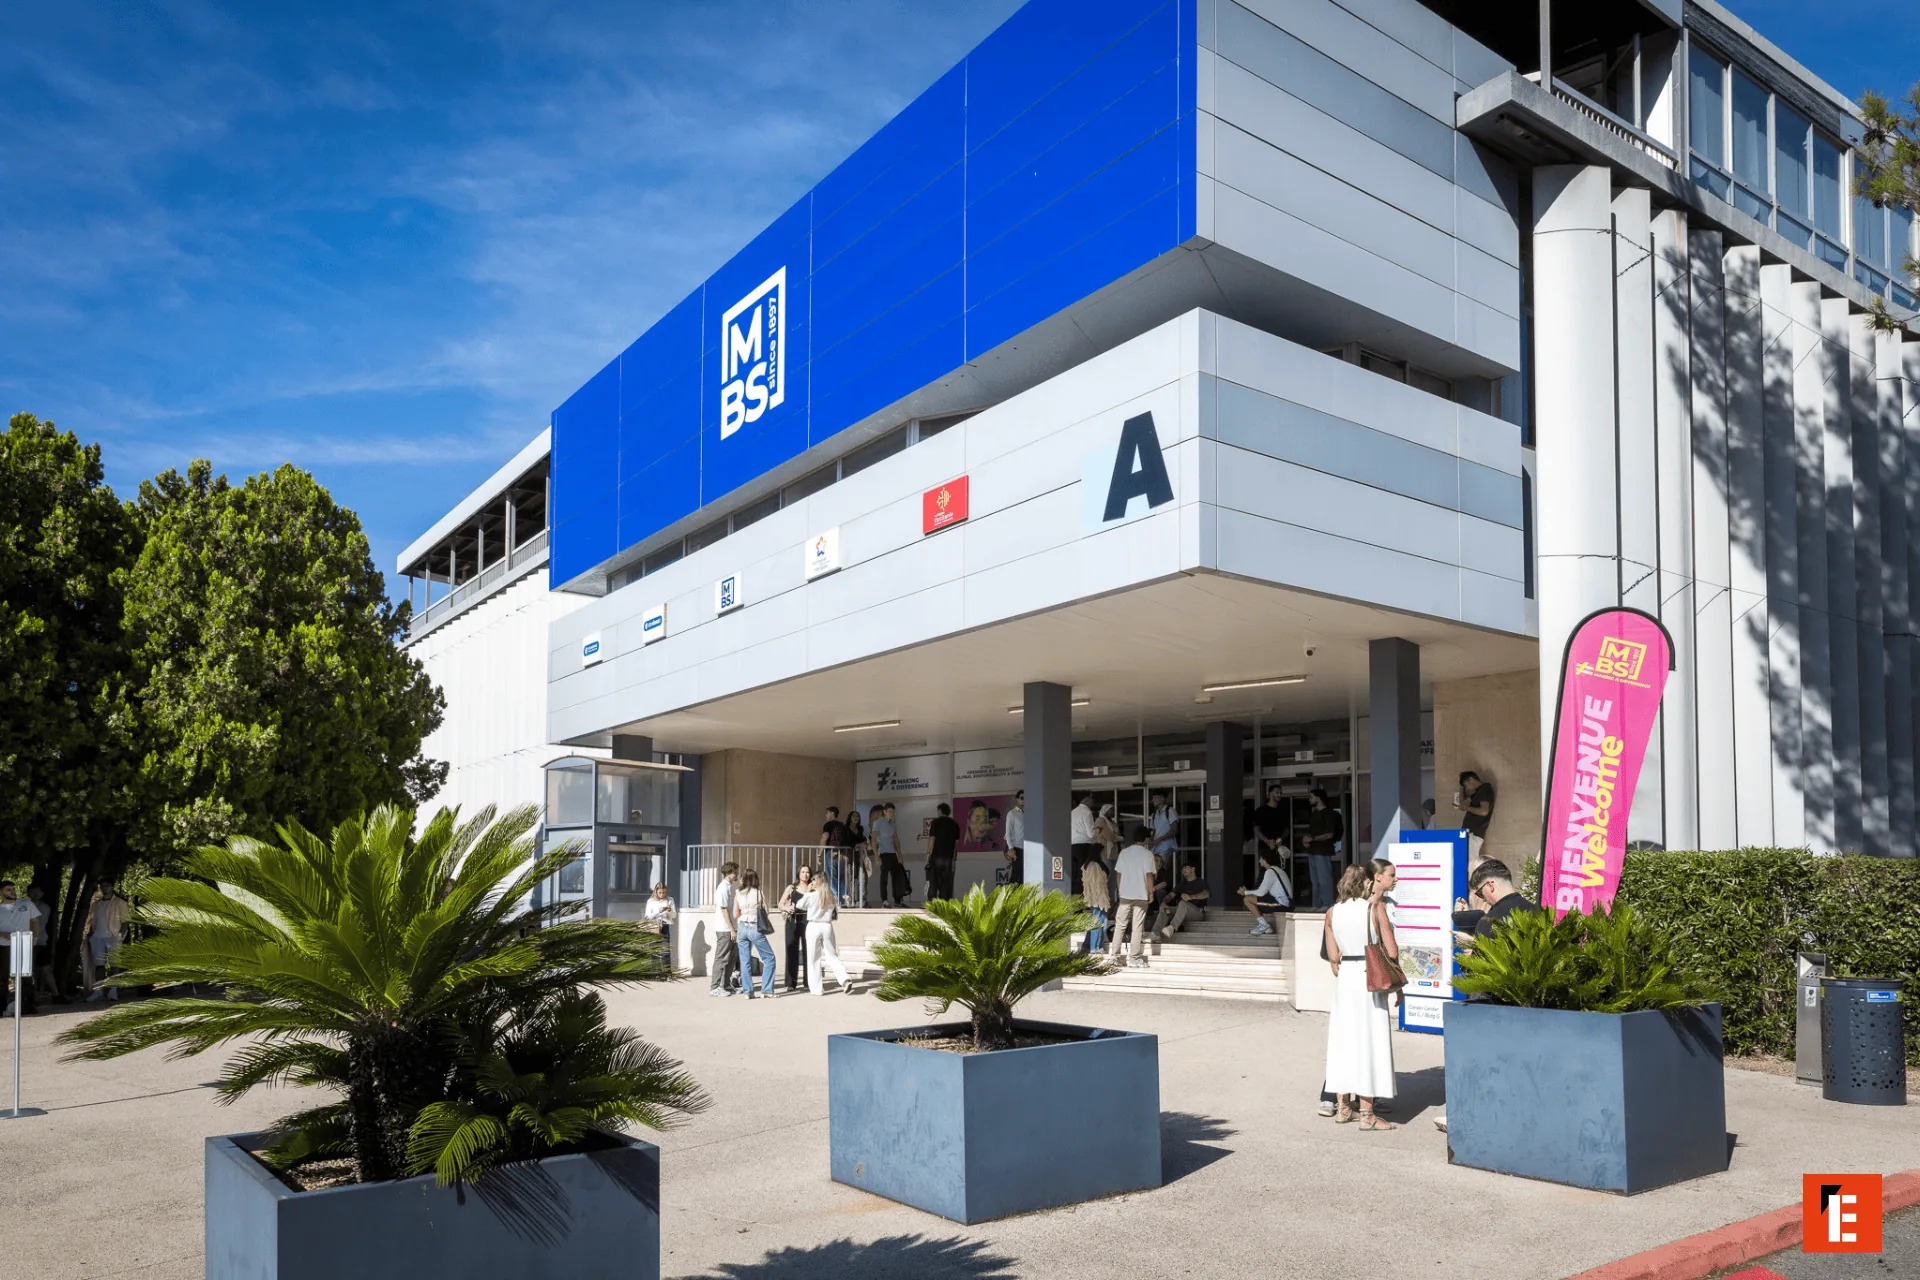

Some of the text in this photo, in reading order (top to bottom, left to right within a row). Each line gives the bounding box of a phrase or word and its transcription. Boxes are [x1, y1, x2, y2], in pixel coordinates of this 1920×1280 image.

[767, 297, 777, 389] since 1897
[1102, 410, 1174, 522] A
[1556, 694, 1613, 912] BIENVENUE
[1580, 735, 1624, 888] Welcome
